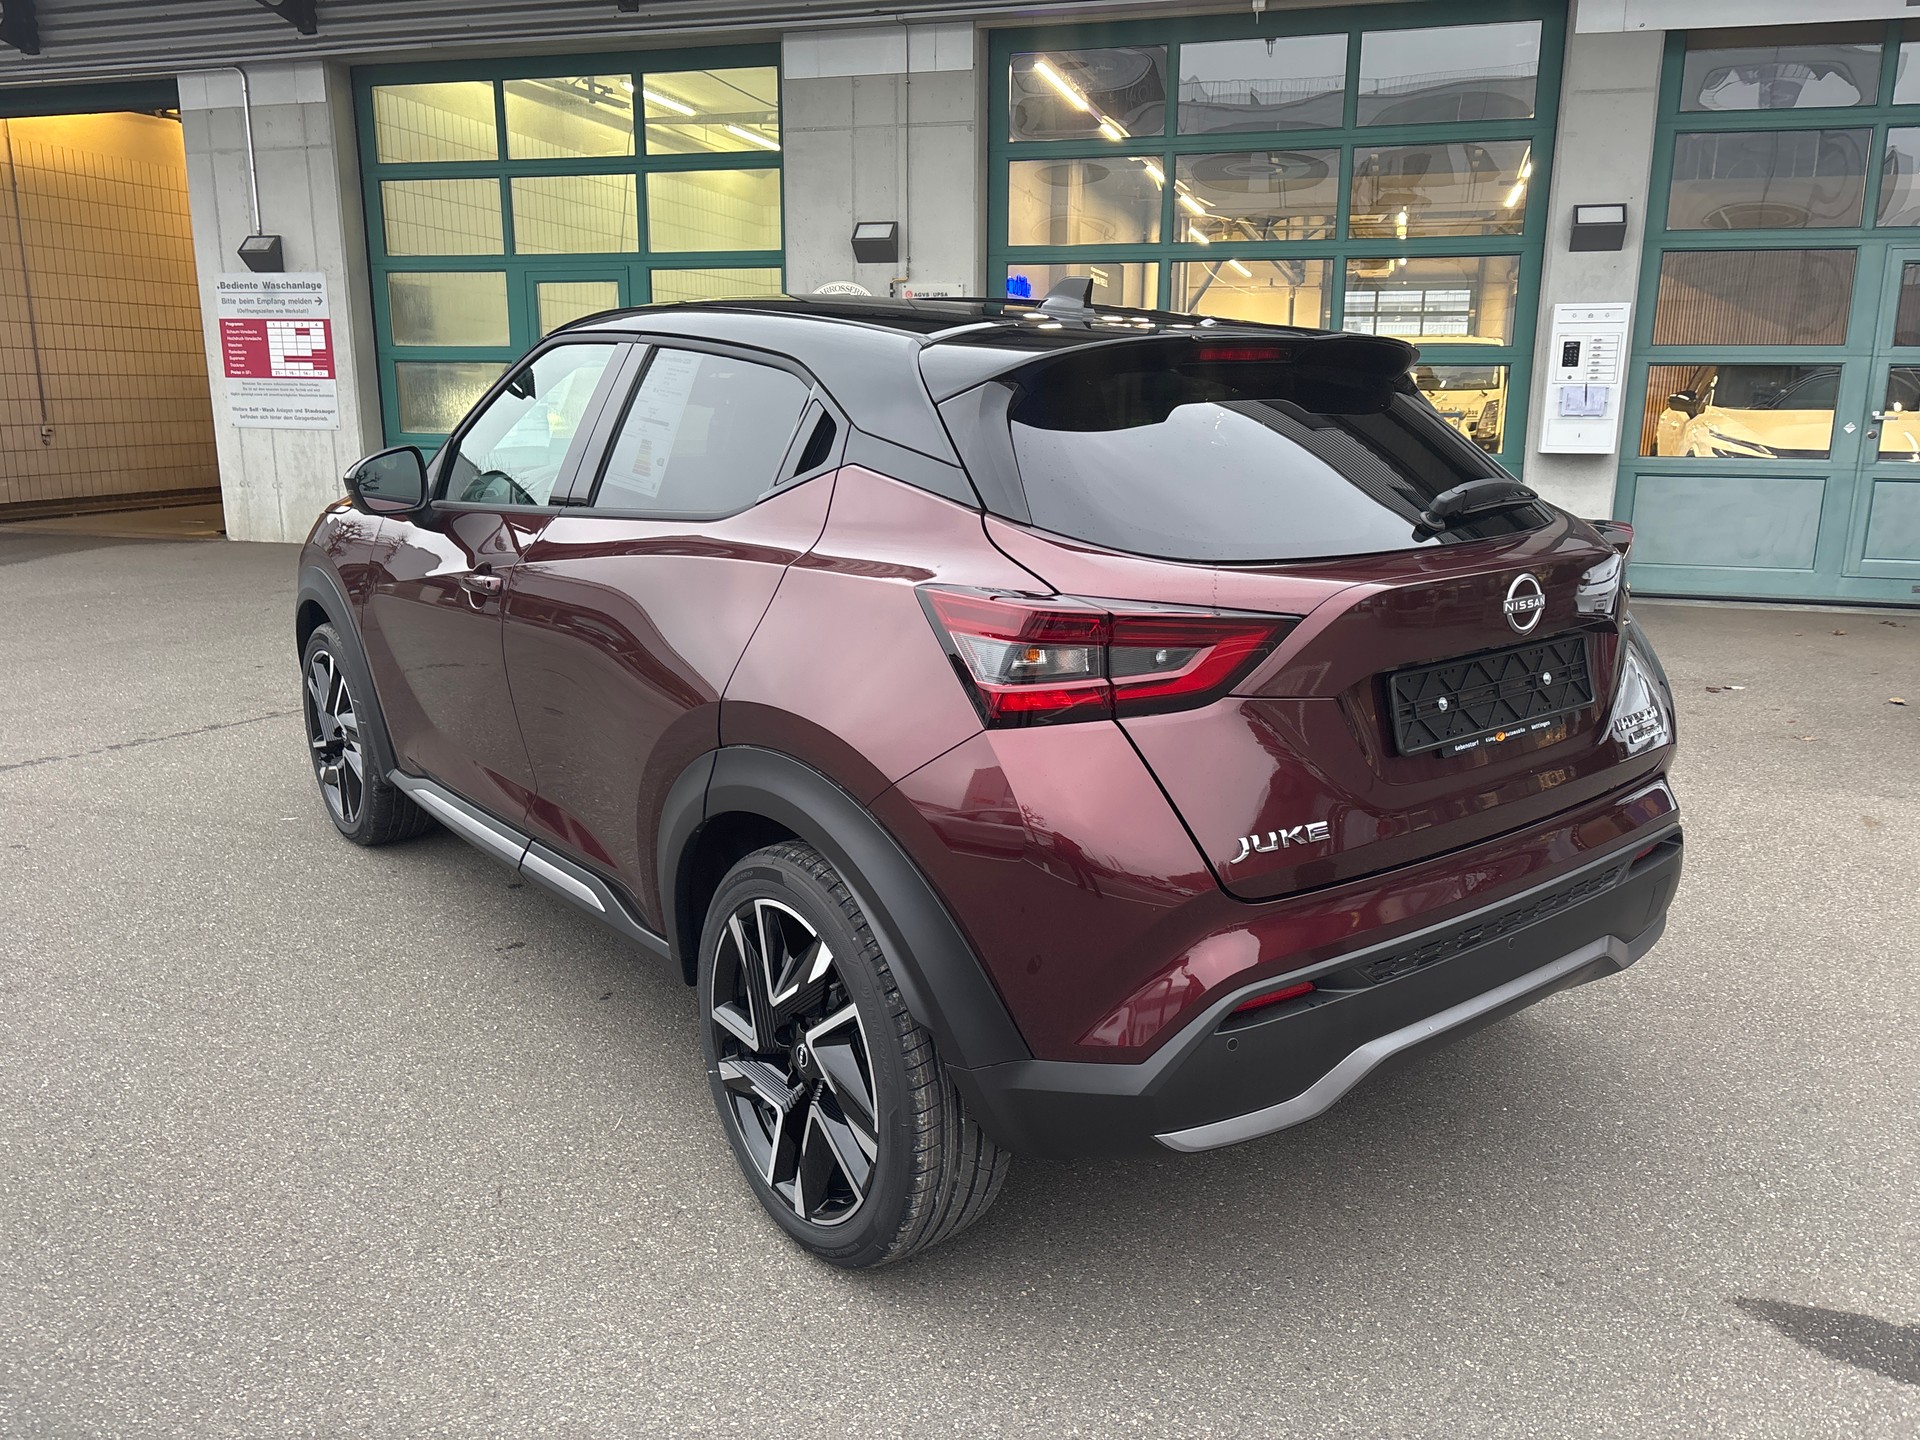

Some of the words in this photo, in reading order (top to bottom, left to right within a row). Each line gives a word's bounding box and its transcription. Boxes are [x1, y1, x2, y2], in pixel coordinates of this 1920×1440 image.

[220, 281, 258, 289] Bediente
[262, 281, 322, 291] Waschanlage
[257, 298, 286, 306] Empfang
[1505, 597, 1545, 612] NISSAN
[1455, 740, 1479, 752] Gebenstorf
[1229, 820, 1331, 865] JUKE
